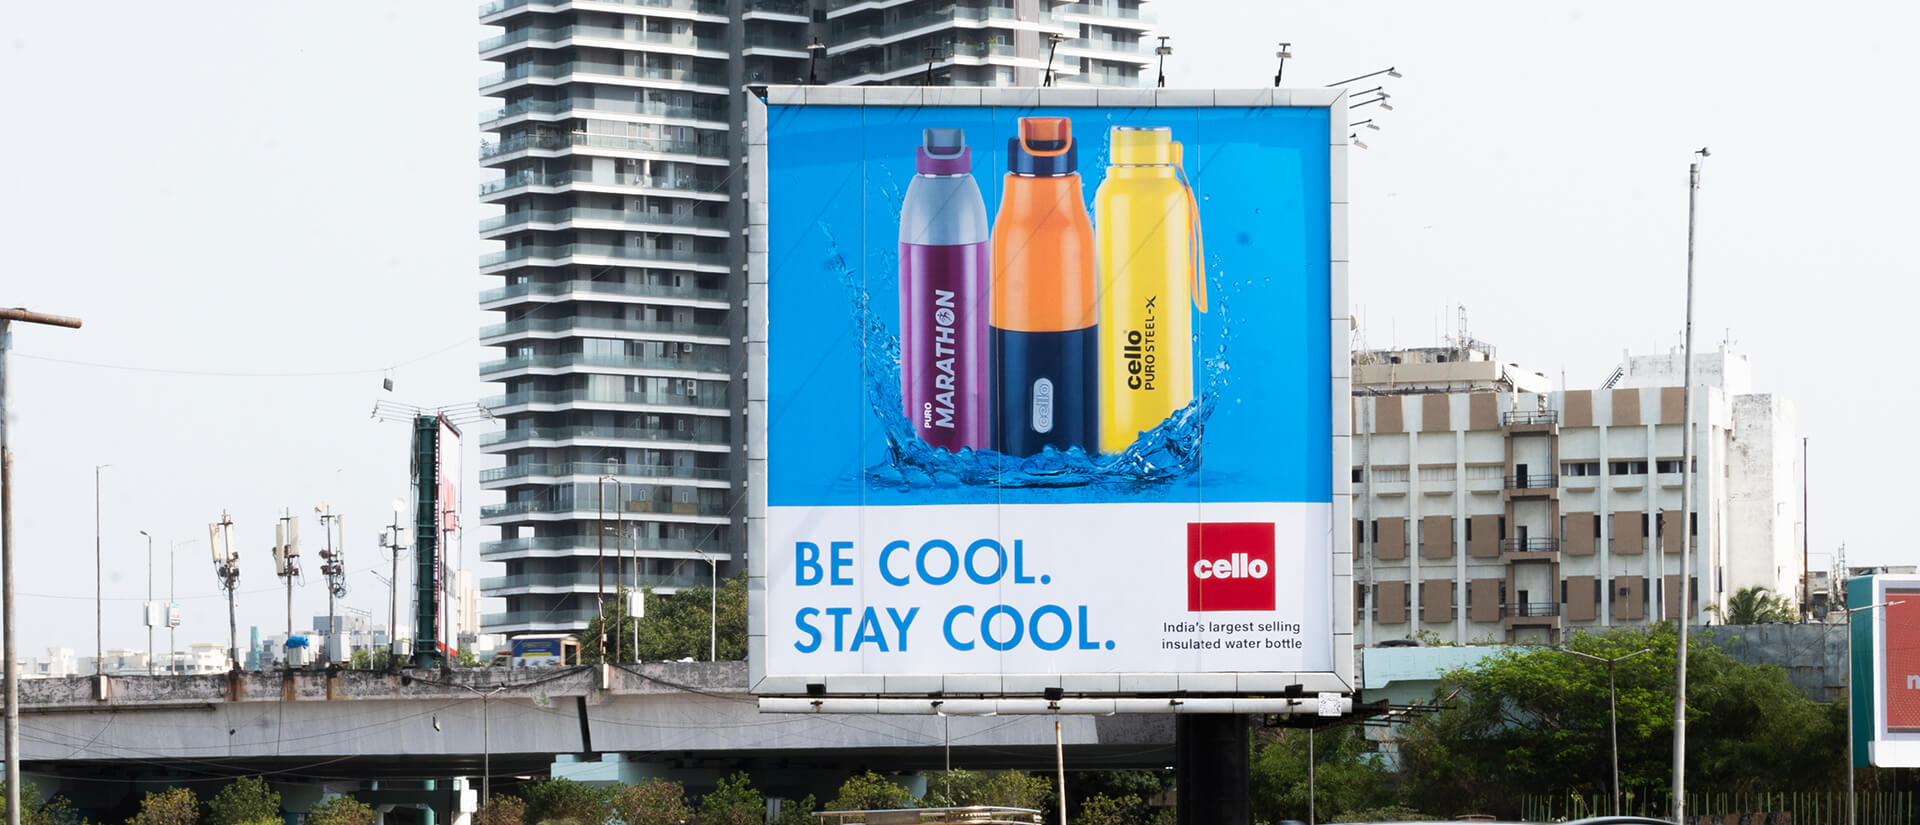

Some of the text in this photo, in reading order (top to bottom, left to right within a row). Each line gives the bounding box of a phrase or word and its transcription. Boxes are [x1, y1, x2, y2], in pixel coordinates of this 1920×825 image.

[935, 289, 955, 429] MARATHON
[1124, 330, 1142, 390] cello
[1144, 354, 1155, 390] PURO
[924, 402, 932, 429] PURO
[1036, 383, 1049, 428] cello
[795, 539, 1051, 587] BE COOL.
[1193, 552, 1268, 579] cello
[794, 604, 1116, 653] STAY COOL.
[1162, 637, 1303, 650] insulated water bottle
[1163, 621, 1301, 635] India's largest selling
